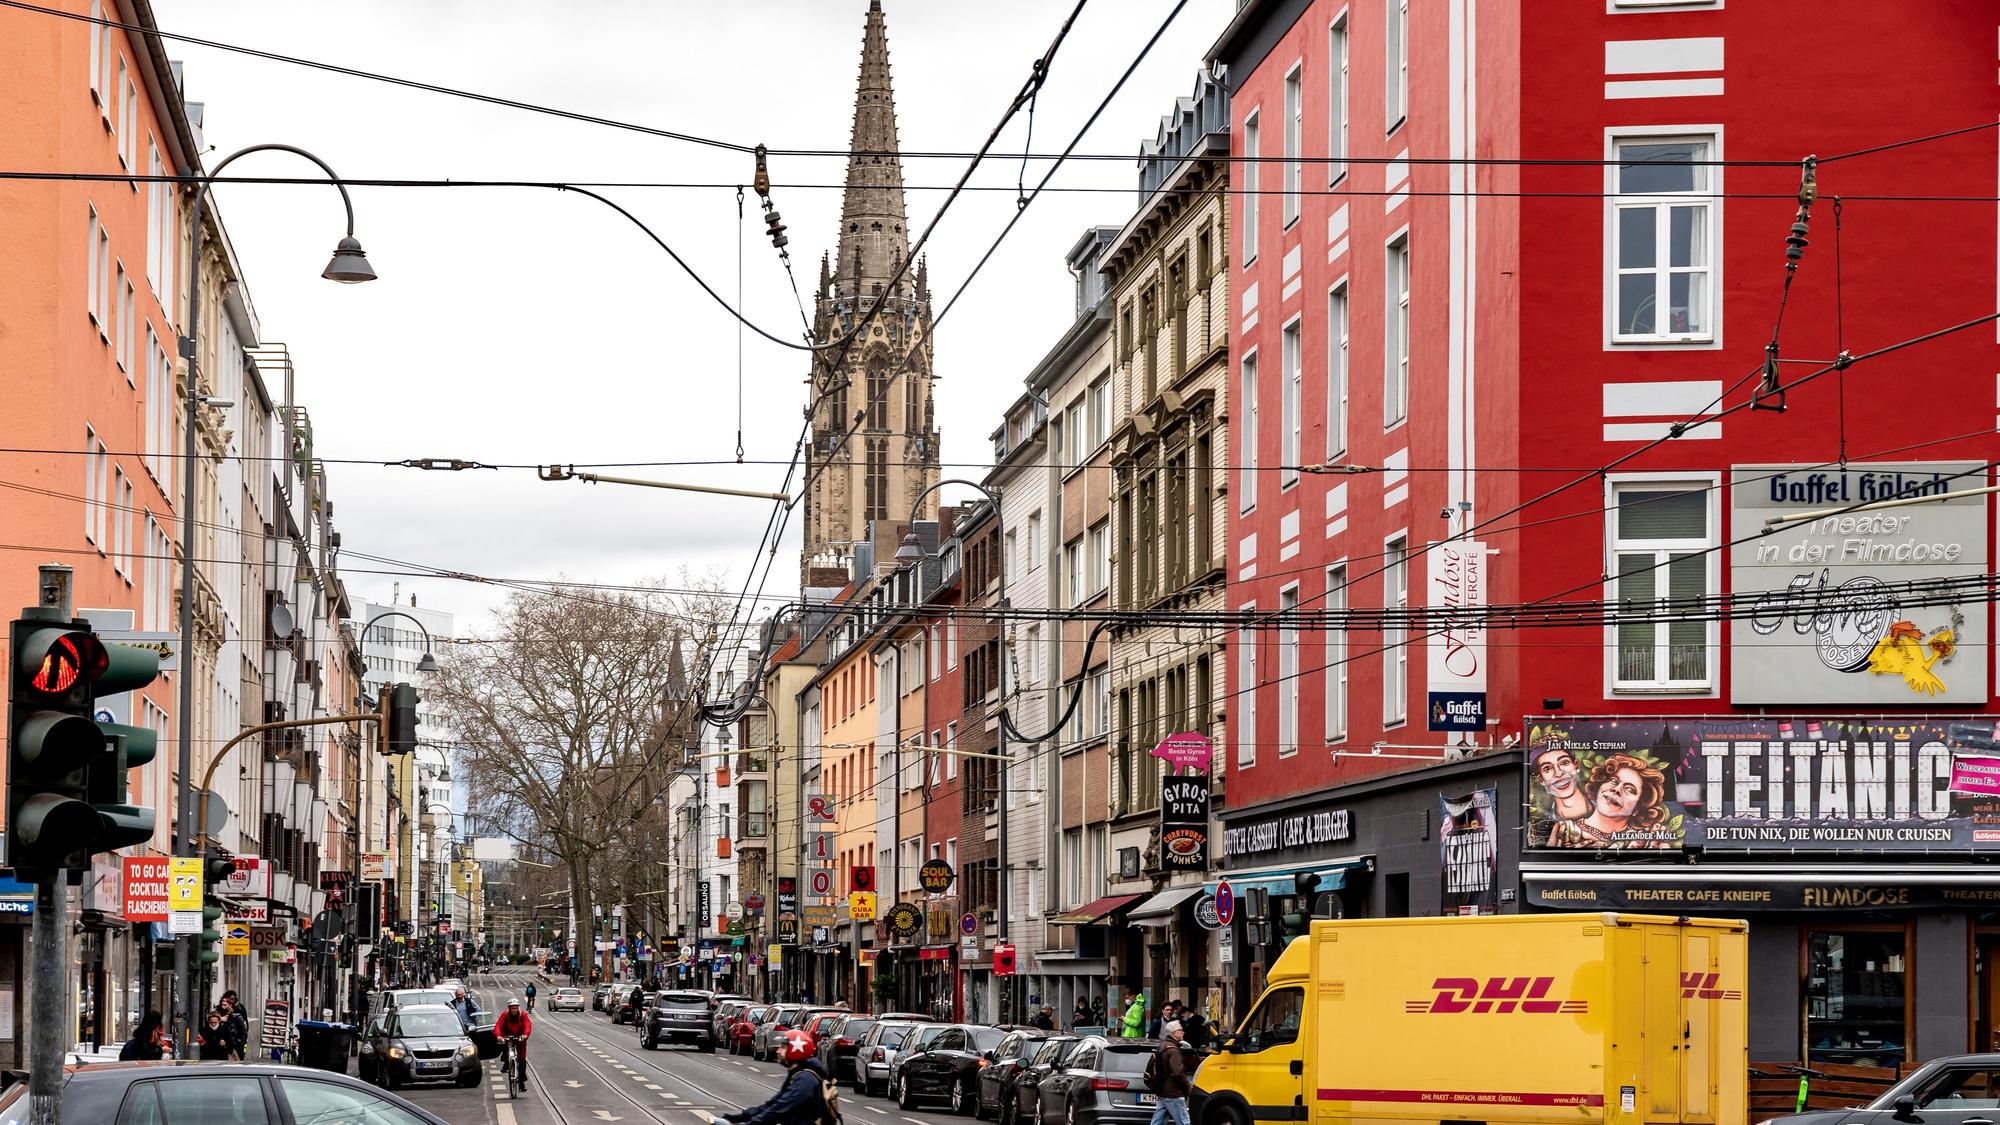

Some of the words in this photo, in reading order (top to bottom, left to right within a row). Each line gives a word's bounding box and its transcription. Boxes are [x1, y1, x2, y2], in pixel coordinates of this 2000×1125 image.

[1770, 473, 1850, 504] Gaffel
[1859, 472, 1949, 503] Kölsch
[1810, 513, 1910, 535] Theater
[1756, 540, 1779, 563] in
[1788, 540, 1834, 563] der
[1840, 539, 1961, 563] Filmdose
[1446, 700, 1483, 715] Gaffel
[1453, 715, 1476, 724] Kölsch
[1547, 740, 1562, 751] JAN
[1564, 741, 1591, 750] NIKLAS
[1593, 740, 1626, 750] STEPHAN
[1701, 740, 1951, 819] TEITÄNIC
[1164, 783, 1208, 803] GYROS
[1172, 803, 1200, 814] PITA
[1163, 829, 1207, 844] CURRYWURST
[1224, 828, 1246, 855] BUTCH
[1247, 822, 1278, 852] CASSIDY
[1283, 817, 1304, 847] CAFE
[1306, 816, 1313, 843] &
[1313, 809, 1349, 842] BURGER
[1611, 831, 1654, 840] ALEXANDER
[1707, 827, 1728, 840] DIE
[1730, 827, 1756, 840] TUN
[1760, 828, 1786, 842] NIX,
[1789, 828, 1809, 840] DIE
[1813, 828, 1864, 840] WOLLEN
[1866, 828, 1895, 840] NUR
[1897, 829, 1951, 841] CRUISEN
[361, 854, 384, 863] Falafel
[1166, 852, 1203, 865] POMMES
[130, 865, 141, 878] TO
[143, 865, 153, 878] GO
[922, 867, 951, 877] SOUL
[129, 882, 169, 896] COCKTAILS
[925, 878, 947, 887] BAR
[1541, 890, 1567, 900] Gaffel
[1568, 890, 1597, 900] Kölsch
[1625, 889, 1684, 900] THEATER
[1687, 890, 1720, 901] CAFE
[1723, 891, 1771, 901] KNEIPE
[1804, 888, 1909, 907] FILMDOSE
[250, 931, 286, 946] IOSK
[1429, 977, 1562, 1013] DHL
[1498, 1094, 1523, 1102] ÜBERALL.
